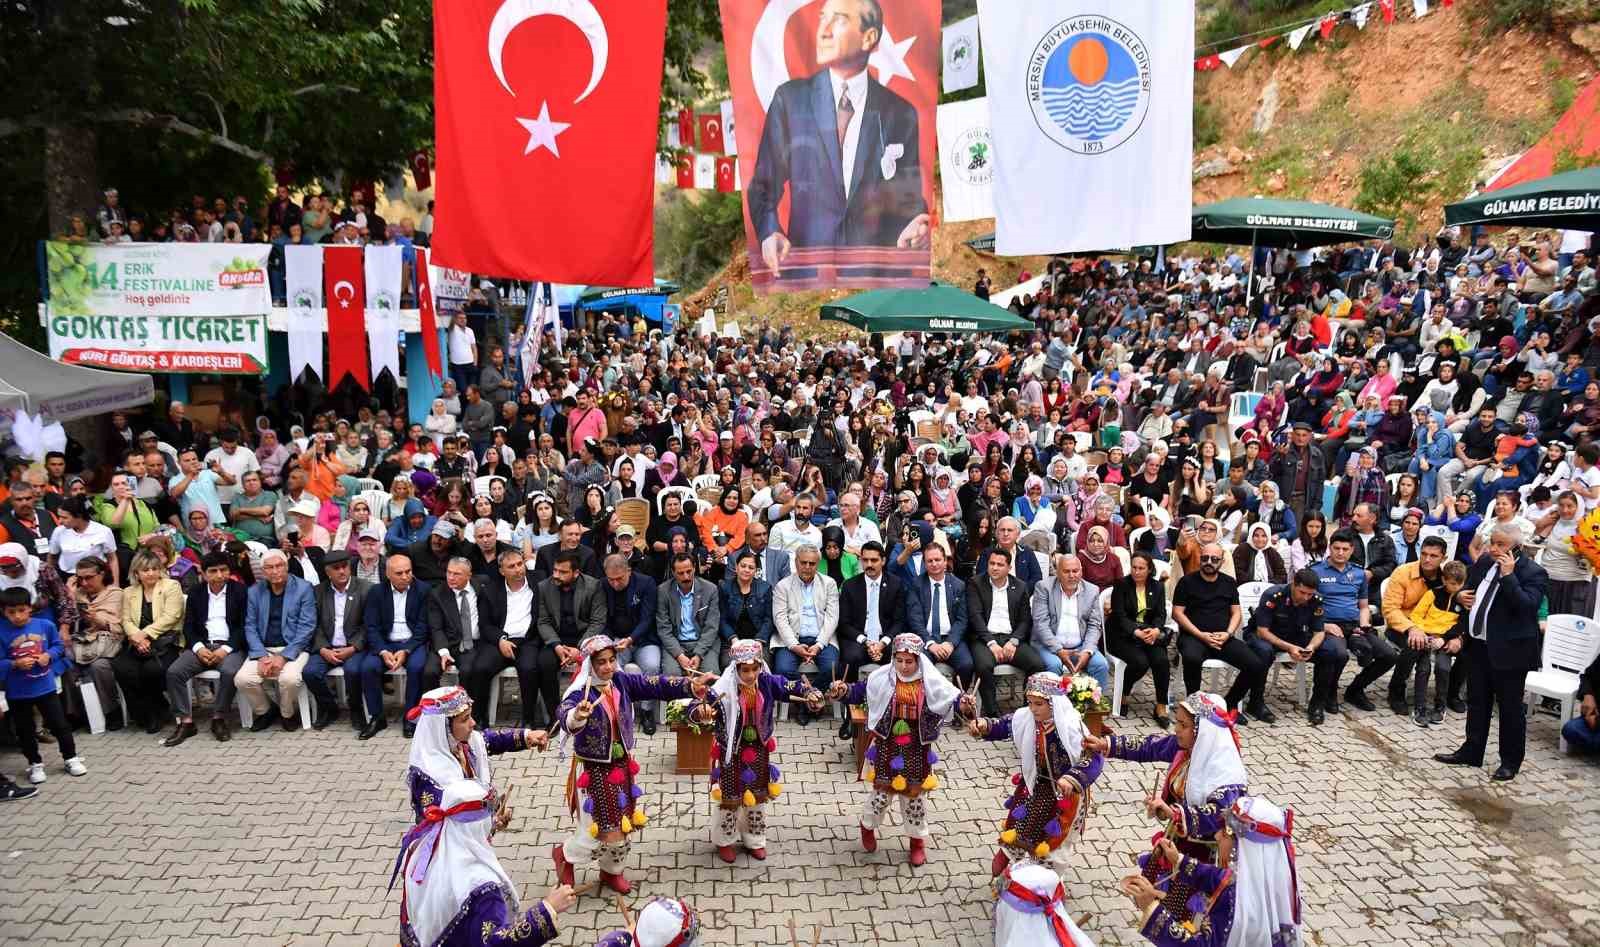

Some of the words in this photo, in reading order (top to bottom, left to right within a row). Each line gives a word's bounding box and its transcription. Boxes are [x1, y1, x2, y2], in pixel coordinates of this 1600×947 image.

[1030, 53, 1046, 102] MERSİN
[1042, 19, 1111, 53] BÜYÜKŞEHİR
[1113, 28, 1151, 92] BELEDİYESİ
[1083, 141, 1104, 152] 1873
[1483, 200, 1537, 216] GÜLNAR
[1538, 193, 1600, 211] BELEDİY
[1246, 214, 1292, 226] GÜLNAR
[1294, 217, 1358, 231] BELEDİYESİ
[124, 263, 154, 275] ERİK
[123, 278, 215, 292] FESTİVALİNE
[125, 294, 145, 307] Hoş
[147, 294, 191, 307] geldiniz
[159, 355, 169, 367] &
[172, 353, 242, 370] KARDEŞLERİ
